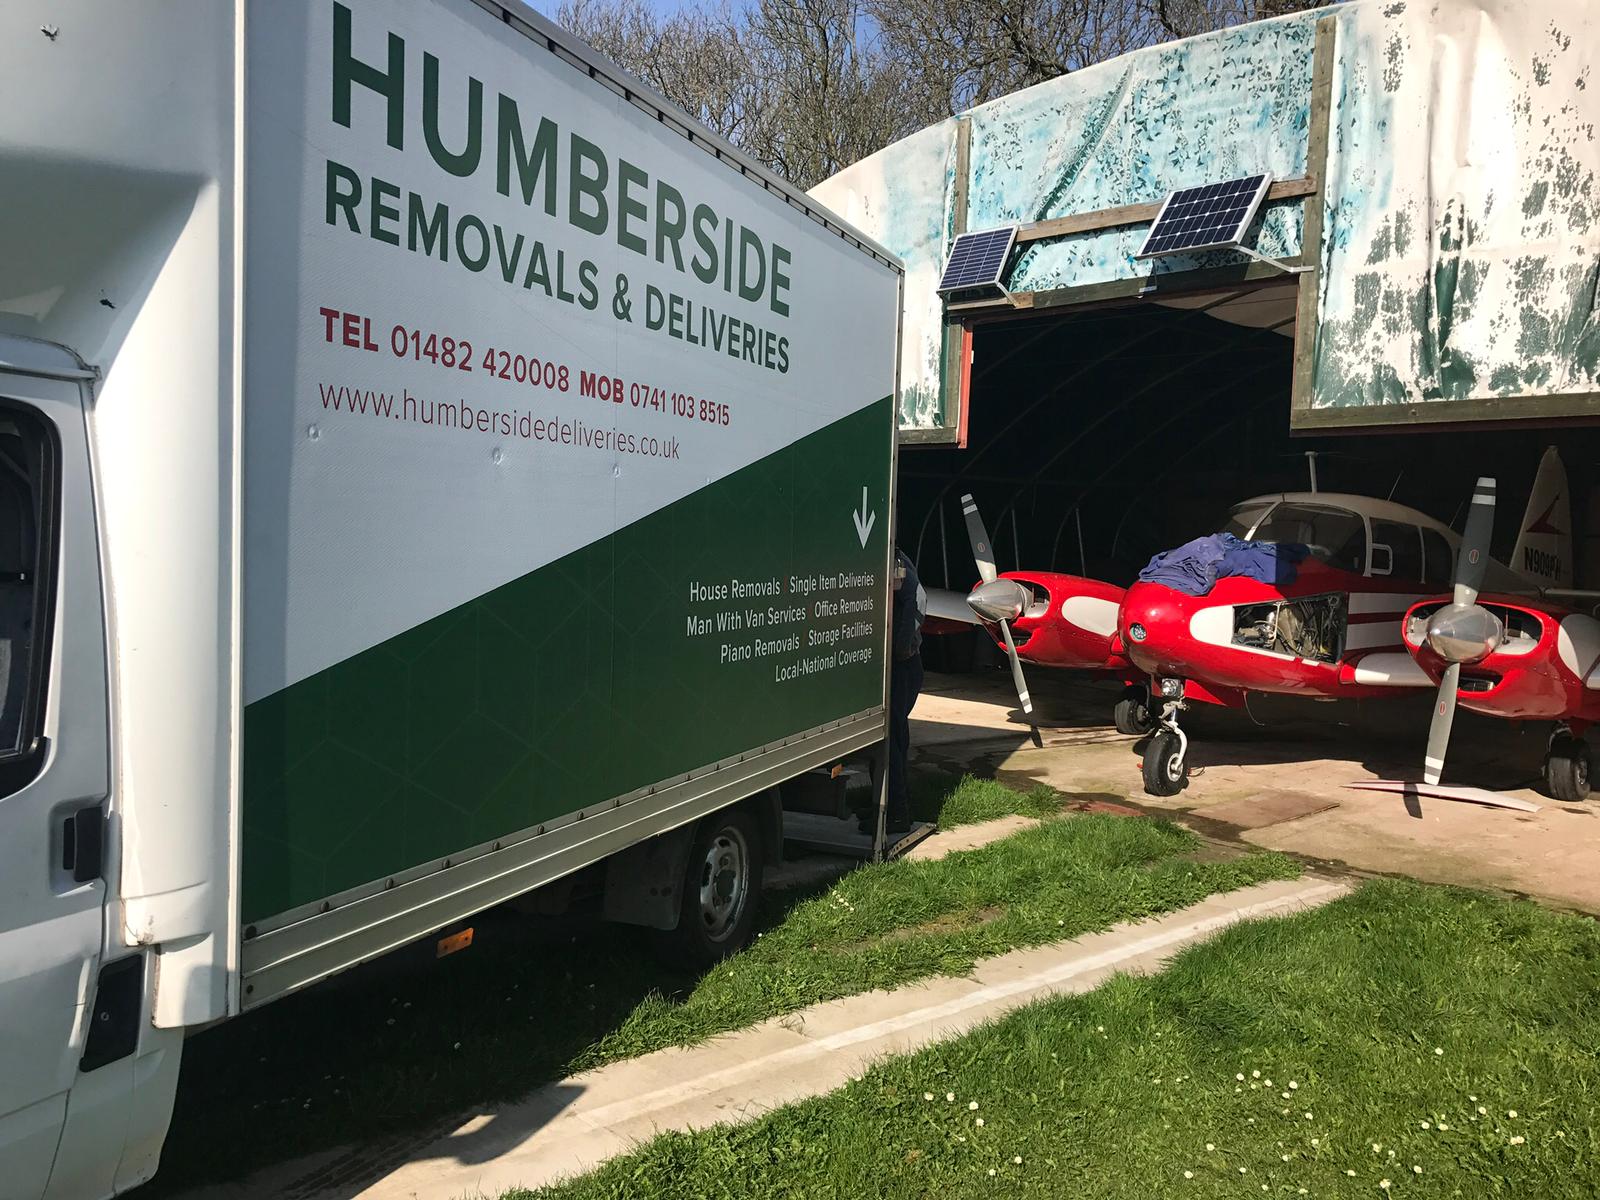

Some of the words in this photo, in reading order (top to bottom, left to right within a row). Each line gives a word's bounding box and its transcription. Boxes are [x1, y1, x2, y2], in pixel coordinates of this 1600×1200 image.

[332, 1, 791, 317] HUMBERSIDE
[326, 159, 599, 310] REMOVALS
[612, 273, 632, 323] &
[646, 284, 790, 374] DELIVERIES
[320, 307, 379, 352] TEL
[391, 325, 472, 372] 01482
[483, 348, 570, 392] 420008
[580, 370, 625, 404] MOB
[630, 384, 667, 413] 0741
[671, 393, 695, 419] 103
[699, 399, 730, 426] 8515
[319, 383, 680, 460] www.humbersidedeliveries.co.uk
[687, 615, 712, 636] Man
[716, 611, 742, 632] With
[745, 609, 765, 628] Van
[767, 606, 806, 626] Services
[814, 600, 838, 618] Office
[840, 596, 874, 614] Removals
[690, 581, 728, 602] House
[732, 577, 780, 598] Removals
[790, 575, 817, 597] Single
[819, 573, 837, 590] Item
[839, 572, 875, 588] Deliveries
[721, 644, 751, 664] Piano
[755, 633, 800, 657] Removals
[808, 627, 840, 647] Storage
[842, 622, 873, 639] Facilities
[775, 652, 837, 682] Local-National
[838, 646, 872, 666] Coverage
